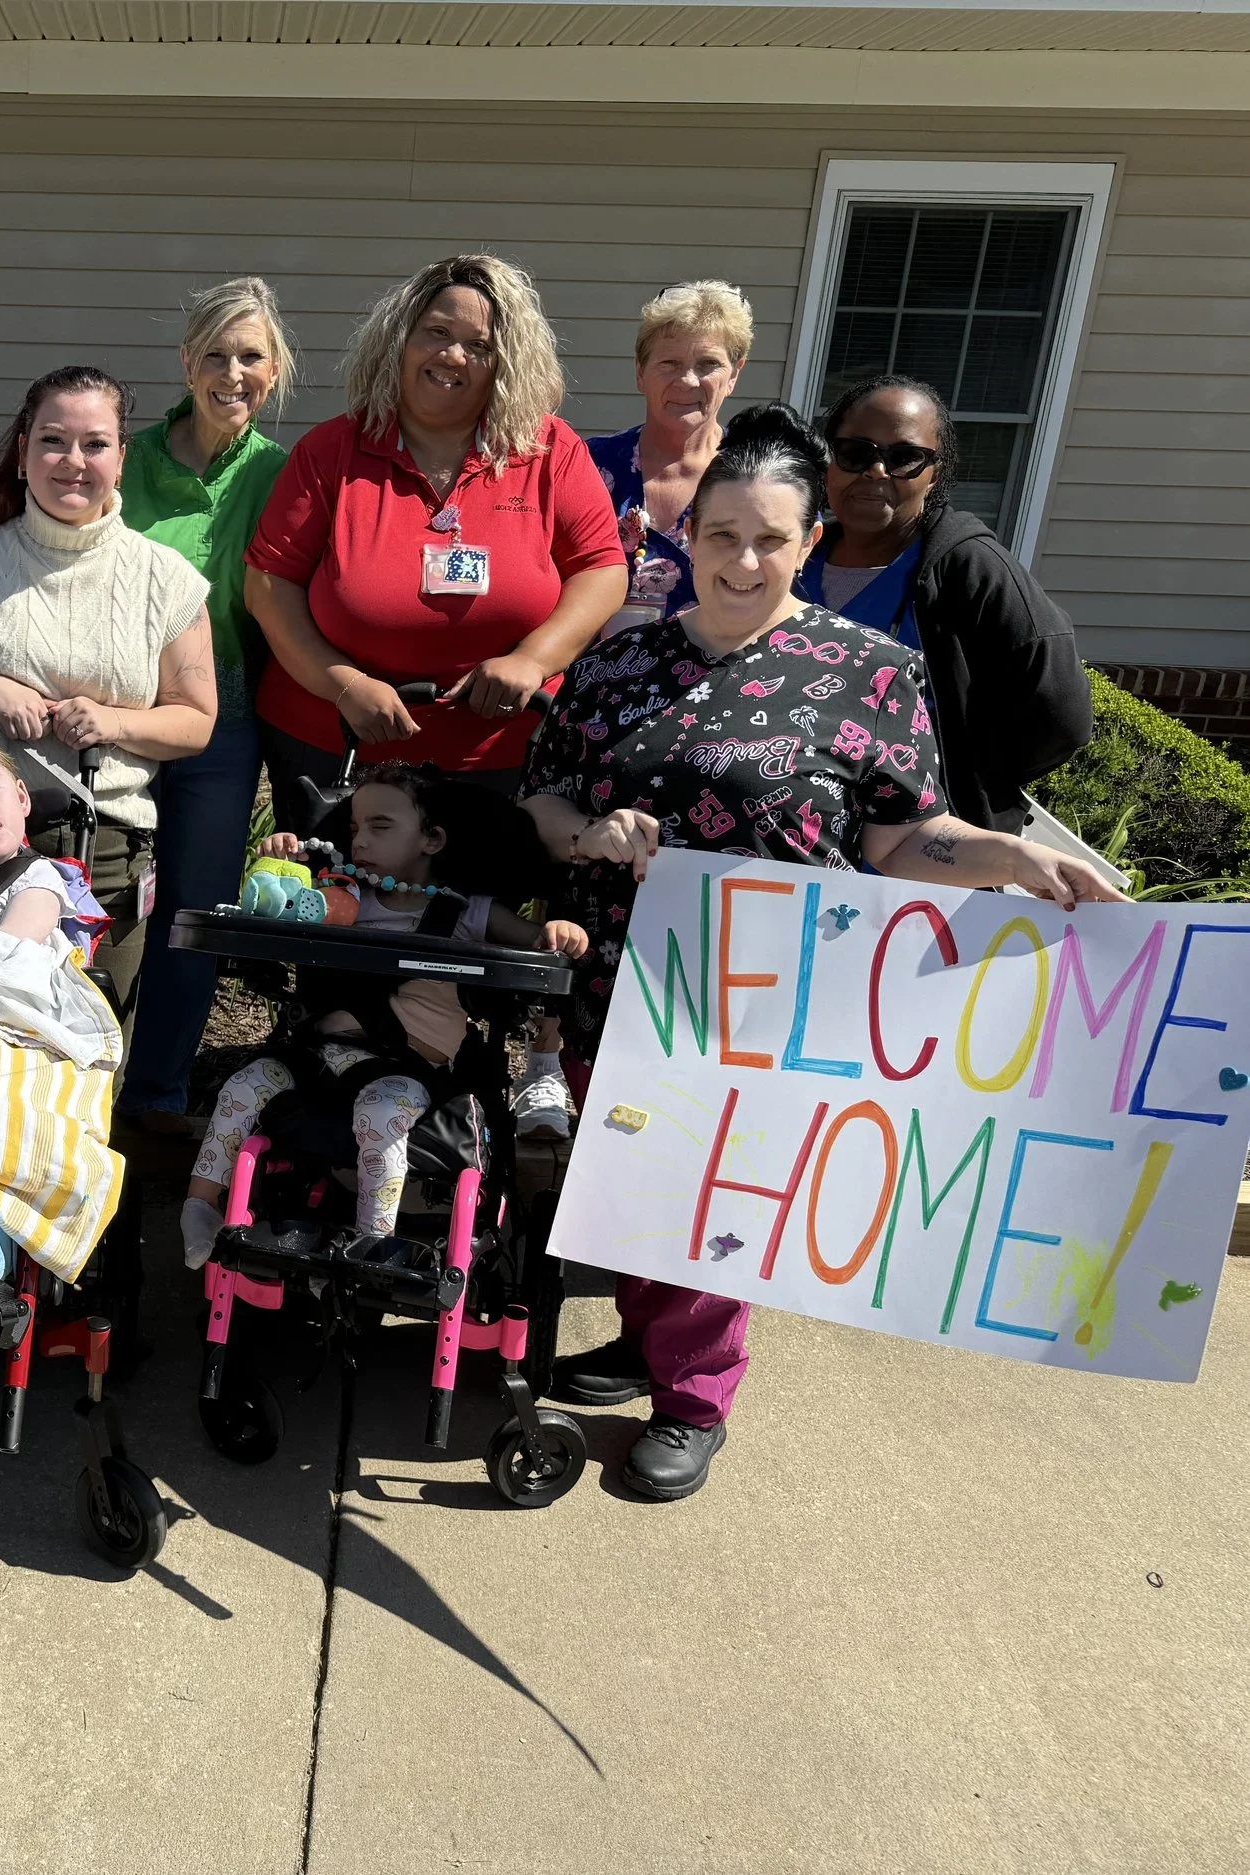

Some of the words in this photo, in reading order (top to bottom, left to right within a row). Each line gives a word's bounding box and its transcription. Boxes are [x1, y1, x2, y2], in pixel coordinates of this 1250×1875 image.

[574, 645, 658, 694] Barbie
[618, 696, 670, 725] Barbie
[684, 735, 801, 779] Barbie
[626, 873, 1250, 1126] WELCOME
[688, 1087, 1173, 1346] HOME!
